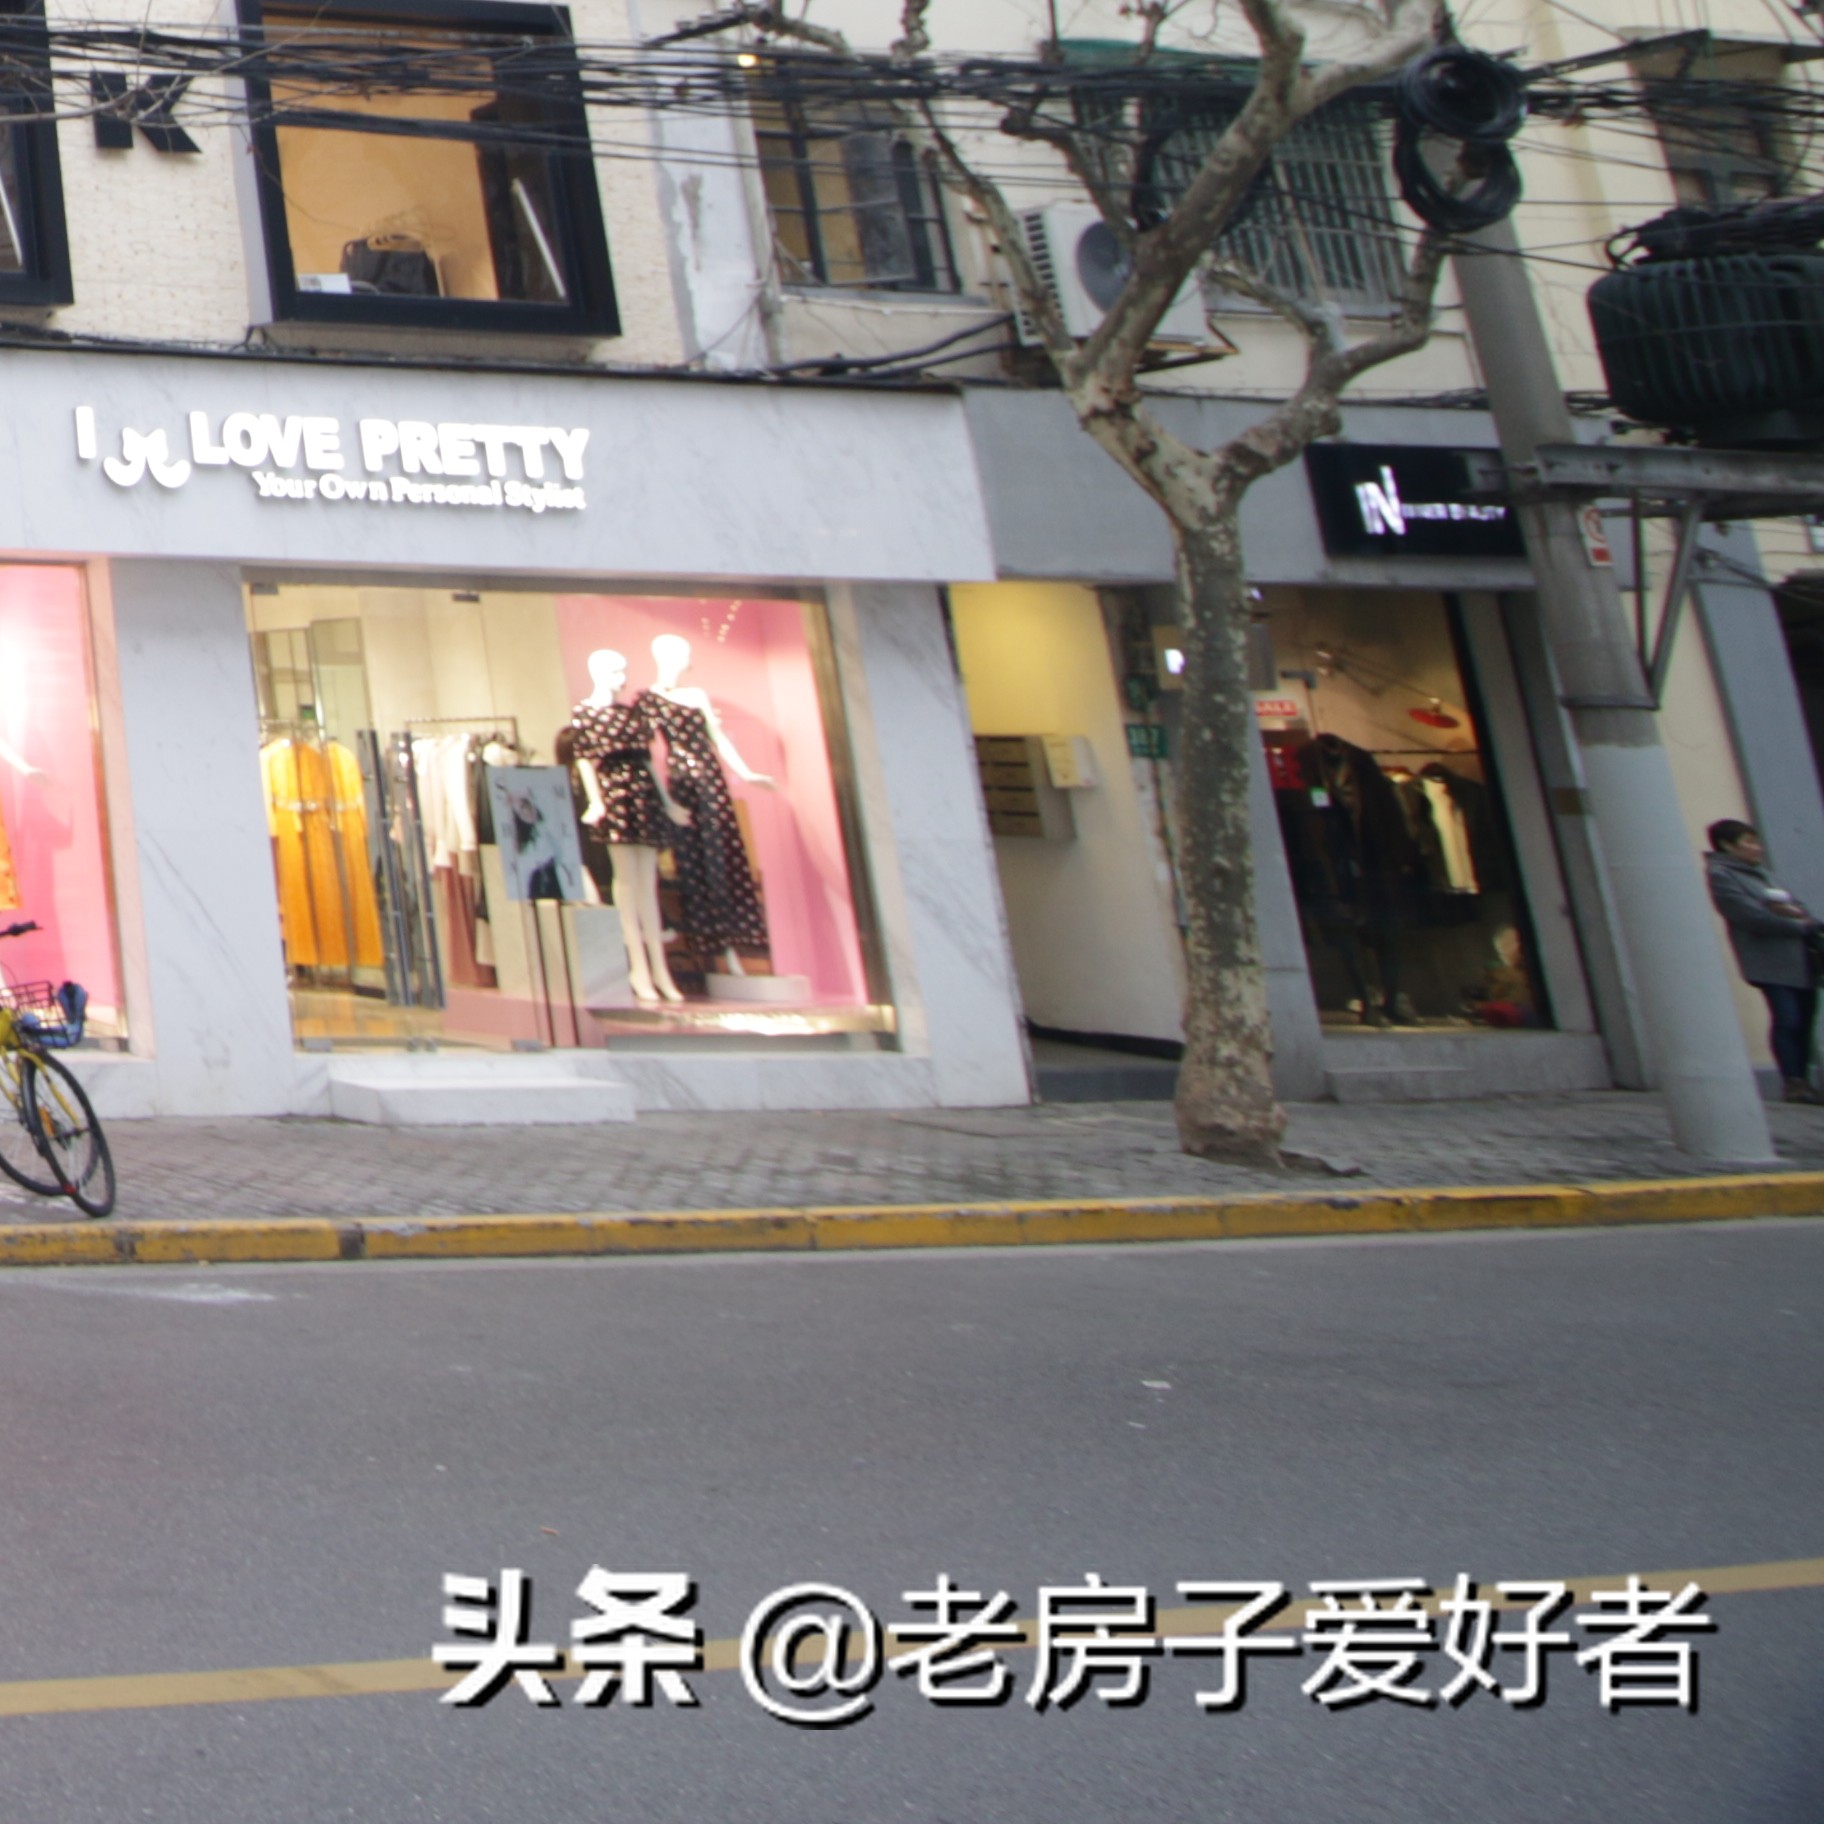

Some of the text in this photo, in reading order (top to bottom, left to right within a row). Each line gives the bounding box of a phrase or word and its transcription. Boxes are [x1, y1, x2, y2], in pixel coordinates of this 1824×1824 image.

[189, 411, 345, 471] LOVE
[360, 419, 590, 479] PRETTY
[253, 472, 586, 513] Your Own Personal Stylist
